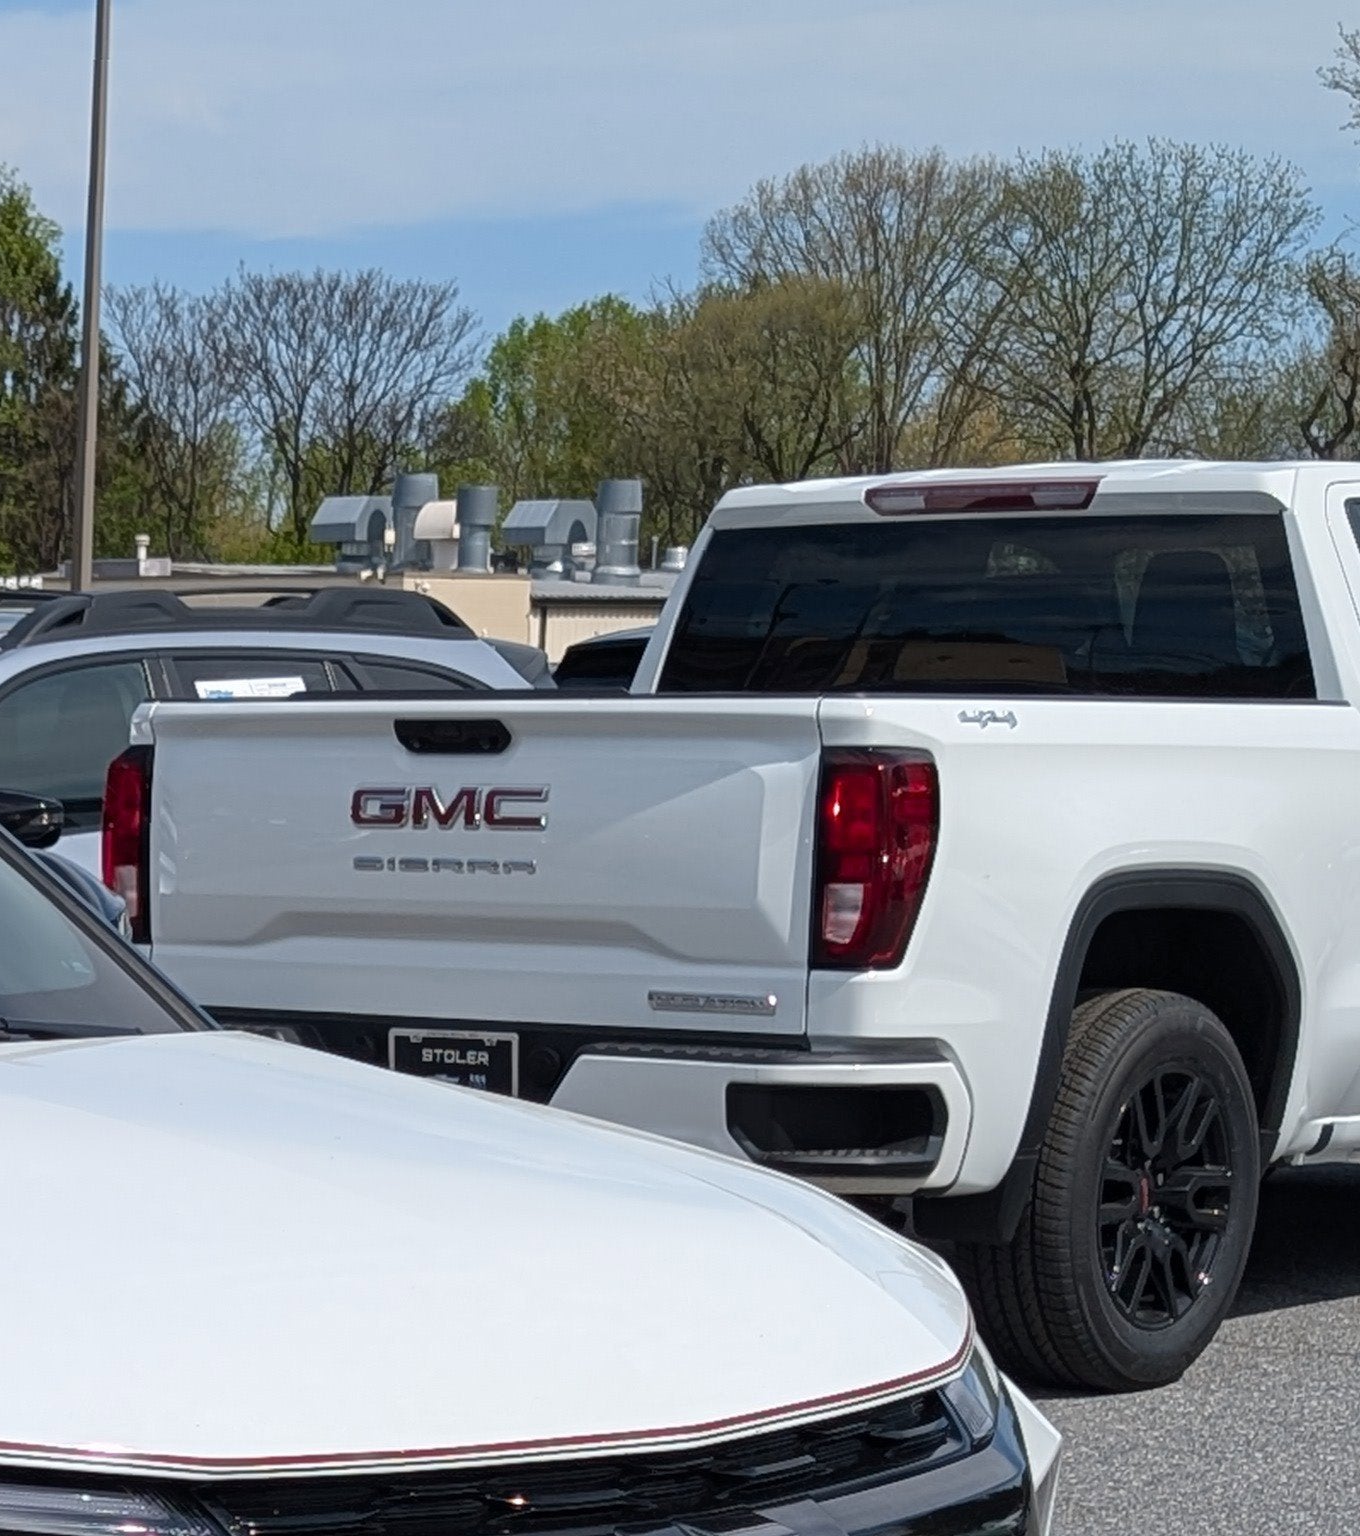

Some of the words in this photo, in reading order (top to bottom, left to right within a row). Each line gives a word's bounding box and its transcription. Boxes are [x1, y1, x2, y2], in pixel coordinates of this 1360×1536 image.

[350, 786, 551, 831] GMC
[353, 856, 537, 875] SIERRA
[421, 1048, 490, 1067] STOLER
